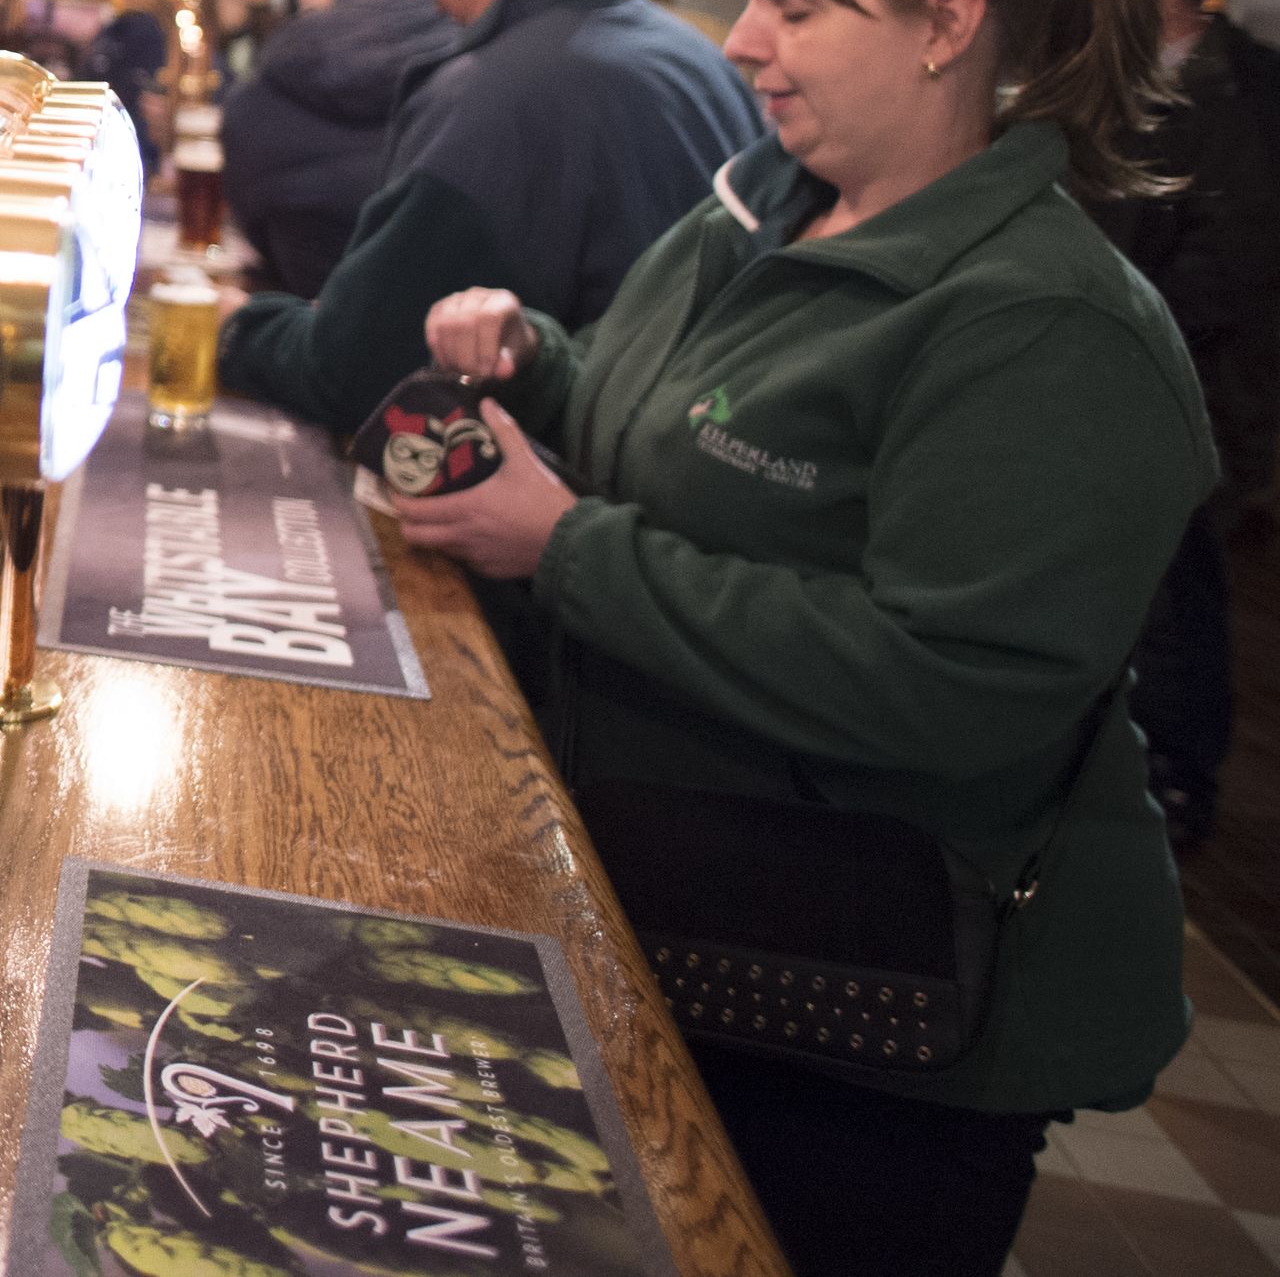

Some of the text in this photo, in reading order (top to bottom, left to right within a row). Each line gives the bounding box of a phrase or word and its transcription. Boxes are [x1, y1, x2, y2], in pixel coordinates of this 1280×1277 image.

[206, 559, 354, 667] BAY
[255, 1027, 287, 1192] SINCE 1698
[307, 1012, 389, 1235] SHEPHERD
[370, 1021, 498, 1258] NEAME
[486, 1104, 520, 1166] OLDEST
